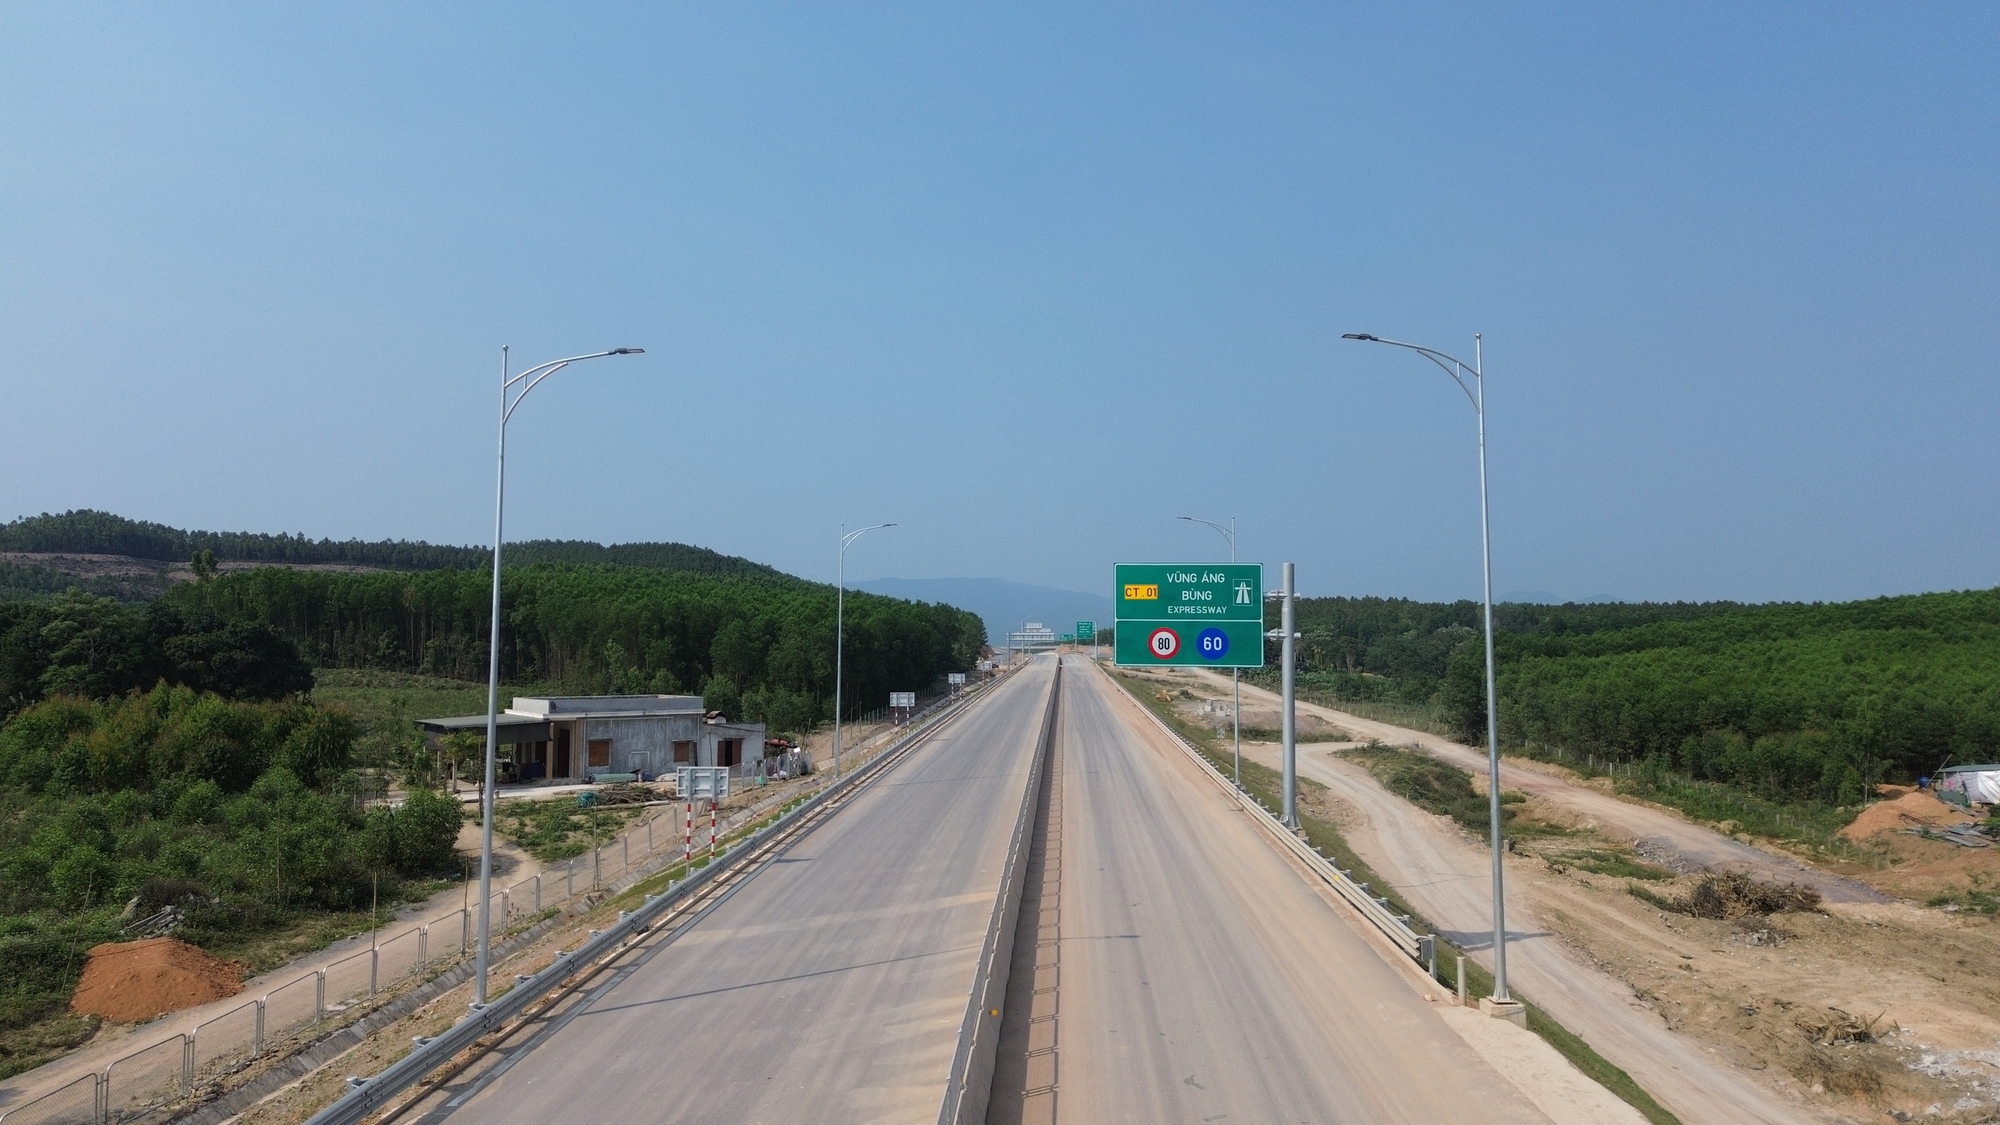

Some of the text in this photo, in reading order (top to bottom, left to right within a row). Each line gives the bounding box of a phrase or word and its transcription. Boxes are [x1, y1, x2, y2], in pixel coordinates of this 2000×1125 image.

[1166, 571, 1225, 583] VŨNG ÁNG
[1182, 590, 1212, 601] BÙNG
[1168, 606, 1227, 614] EXPRESSWAY
[1158, 637, 1170, 650] 80
[1203, 636, 1222, 651] 60
